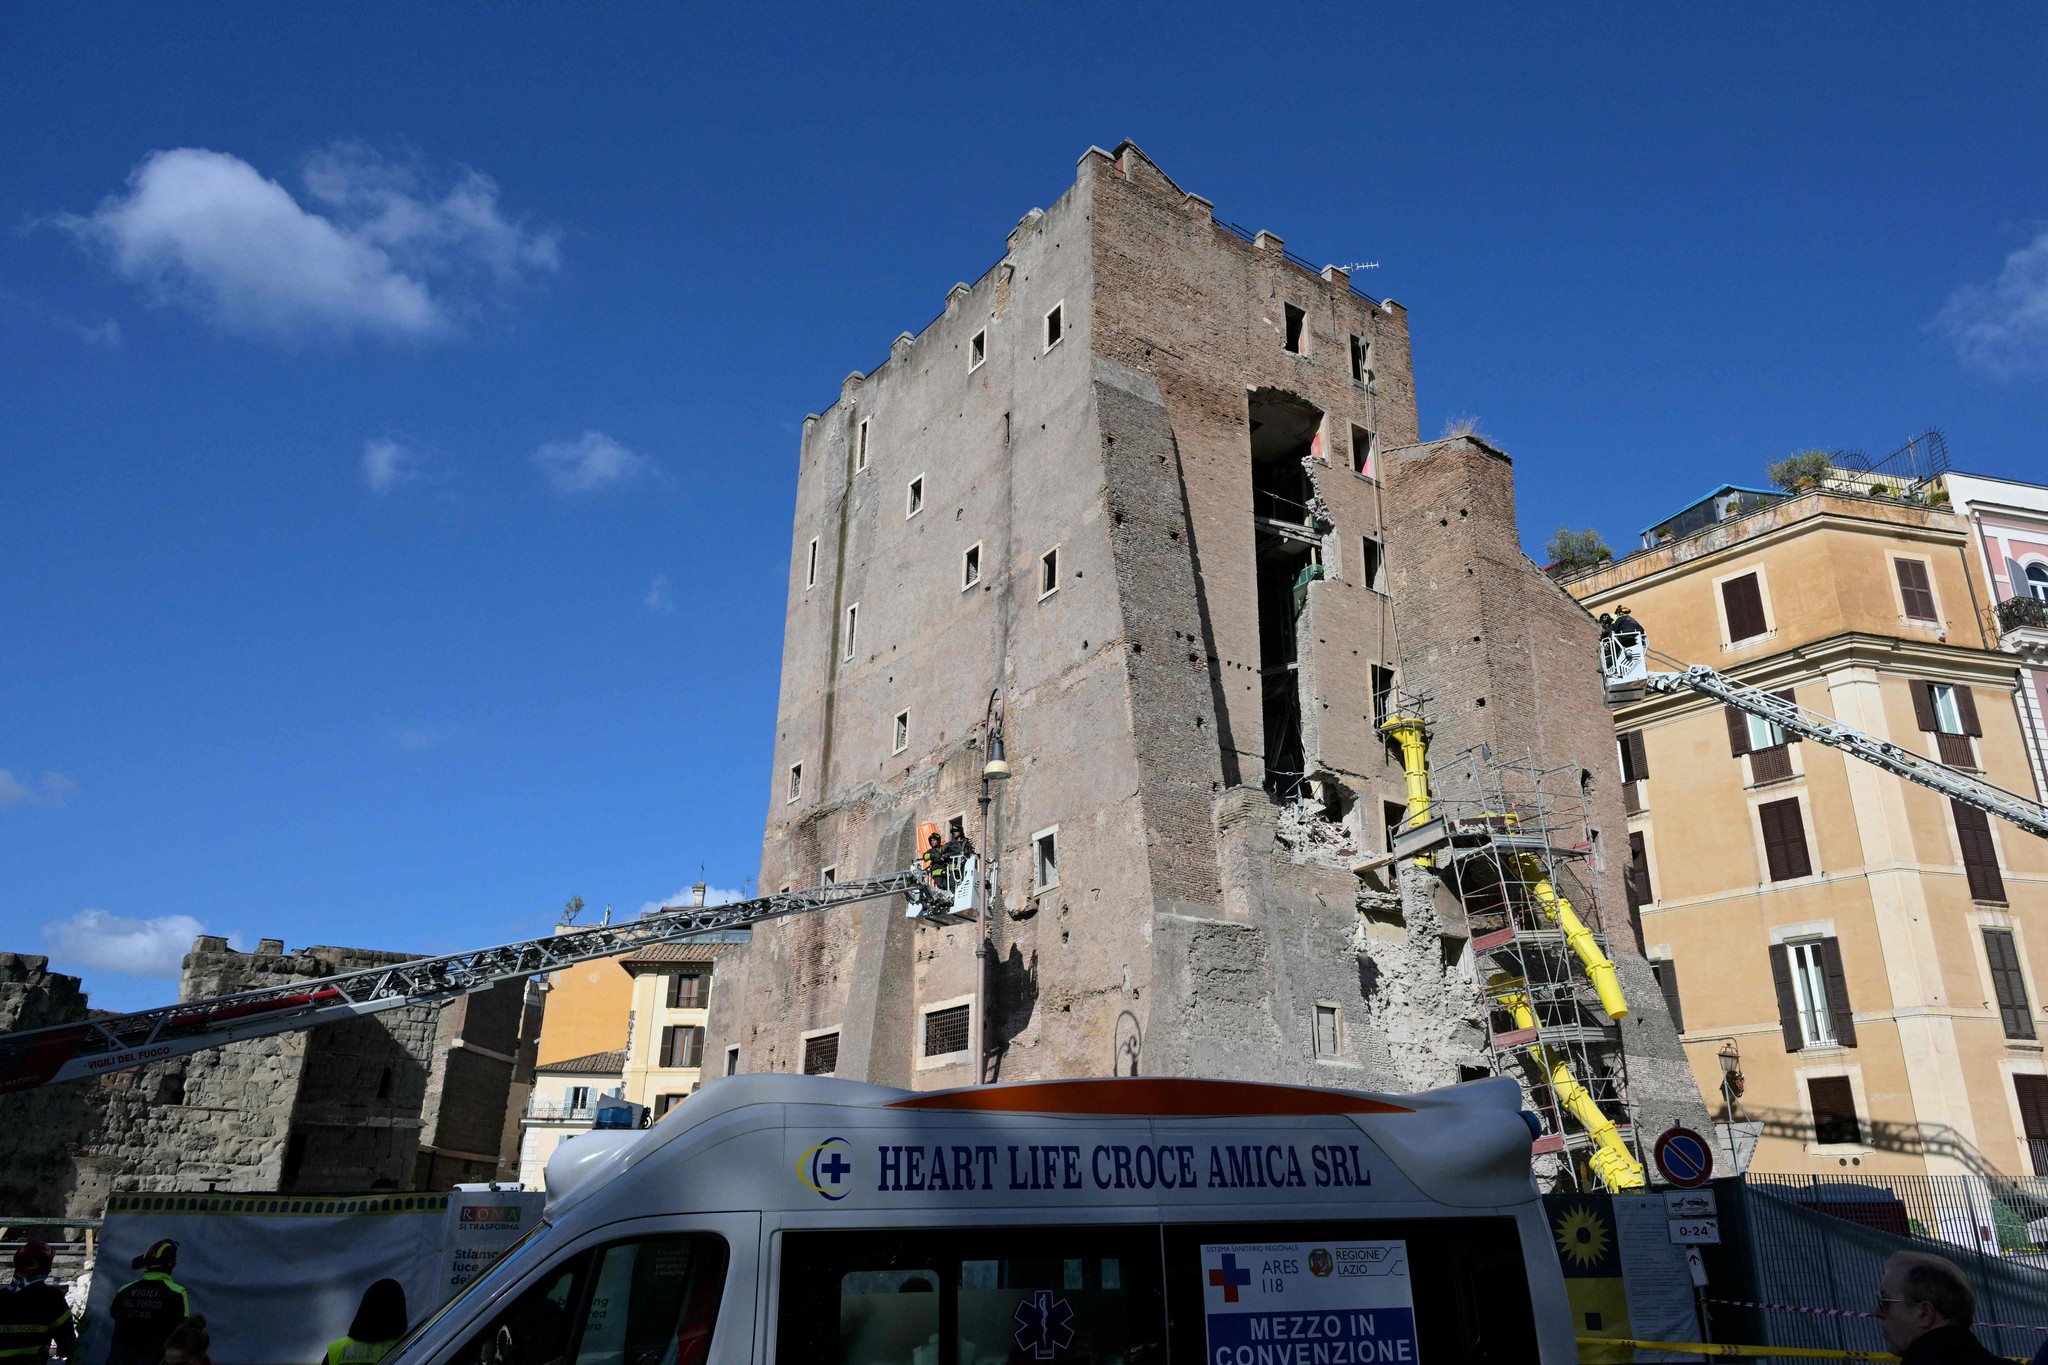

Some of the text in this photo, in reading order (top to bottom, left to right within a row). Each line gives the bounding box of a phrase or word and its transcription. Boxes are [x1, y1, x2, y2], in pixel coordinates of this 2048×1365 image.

[88, 1047, 169, 1069] VIGILI DEL FUOCO
[877, 1145, 1372, 1191] HEART LIFE CROCE AMICA SRL
[462, 1208, 518, 1220] ROMA
[458, 1223, 519, 1231] SI TRASFORMA
[1680, 1226, 1709, 1236] 0-24
[1336, 1250, 1380, 1260] REGIONE
[452, 1261, 480, 1272] luce
[1262, 1260, 1299, 1275] ARES
[1338, 1264, 1367, 1275] LAZIO
[1262, 1278, 1284, 1293] 118
[131, 1288, 159, 1298] VIGILI
[1249, 1314, 1375, 1341] MEZZO IN
[1215, 1339, 1413, 1365] CONVENZIONE
